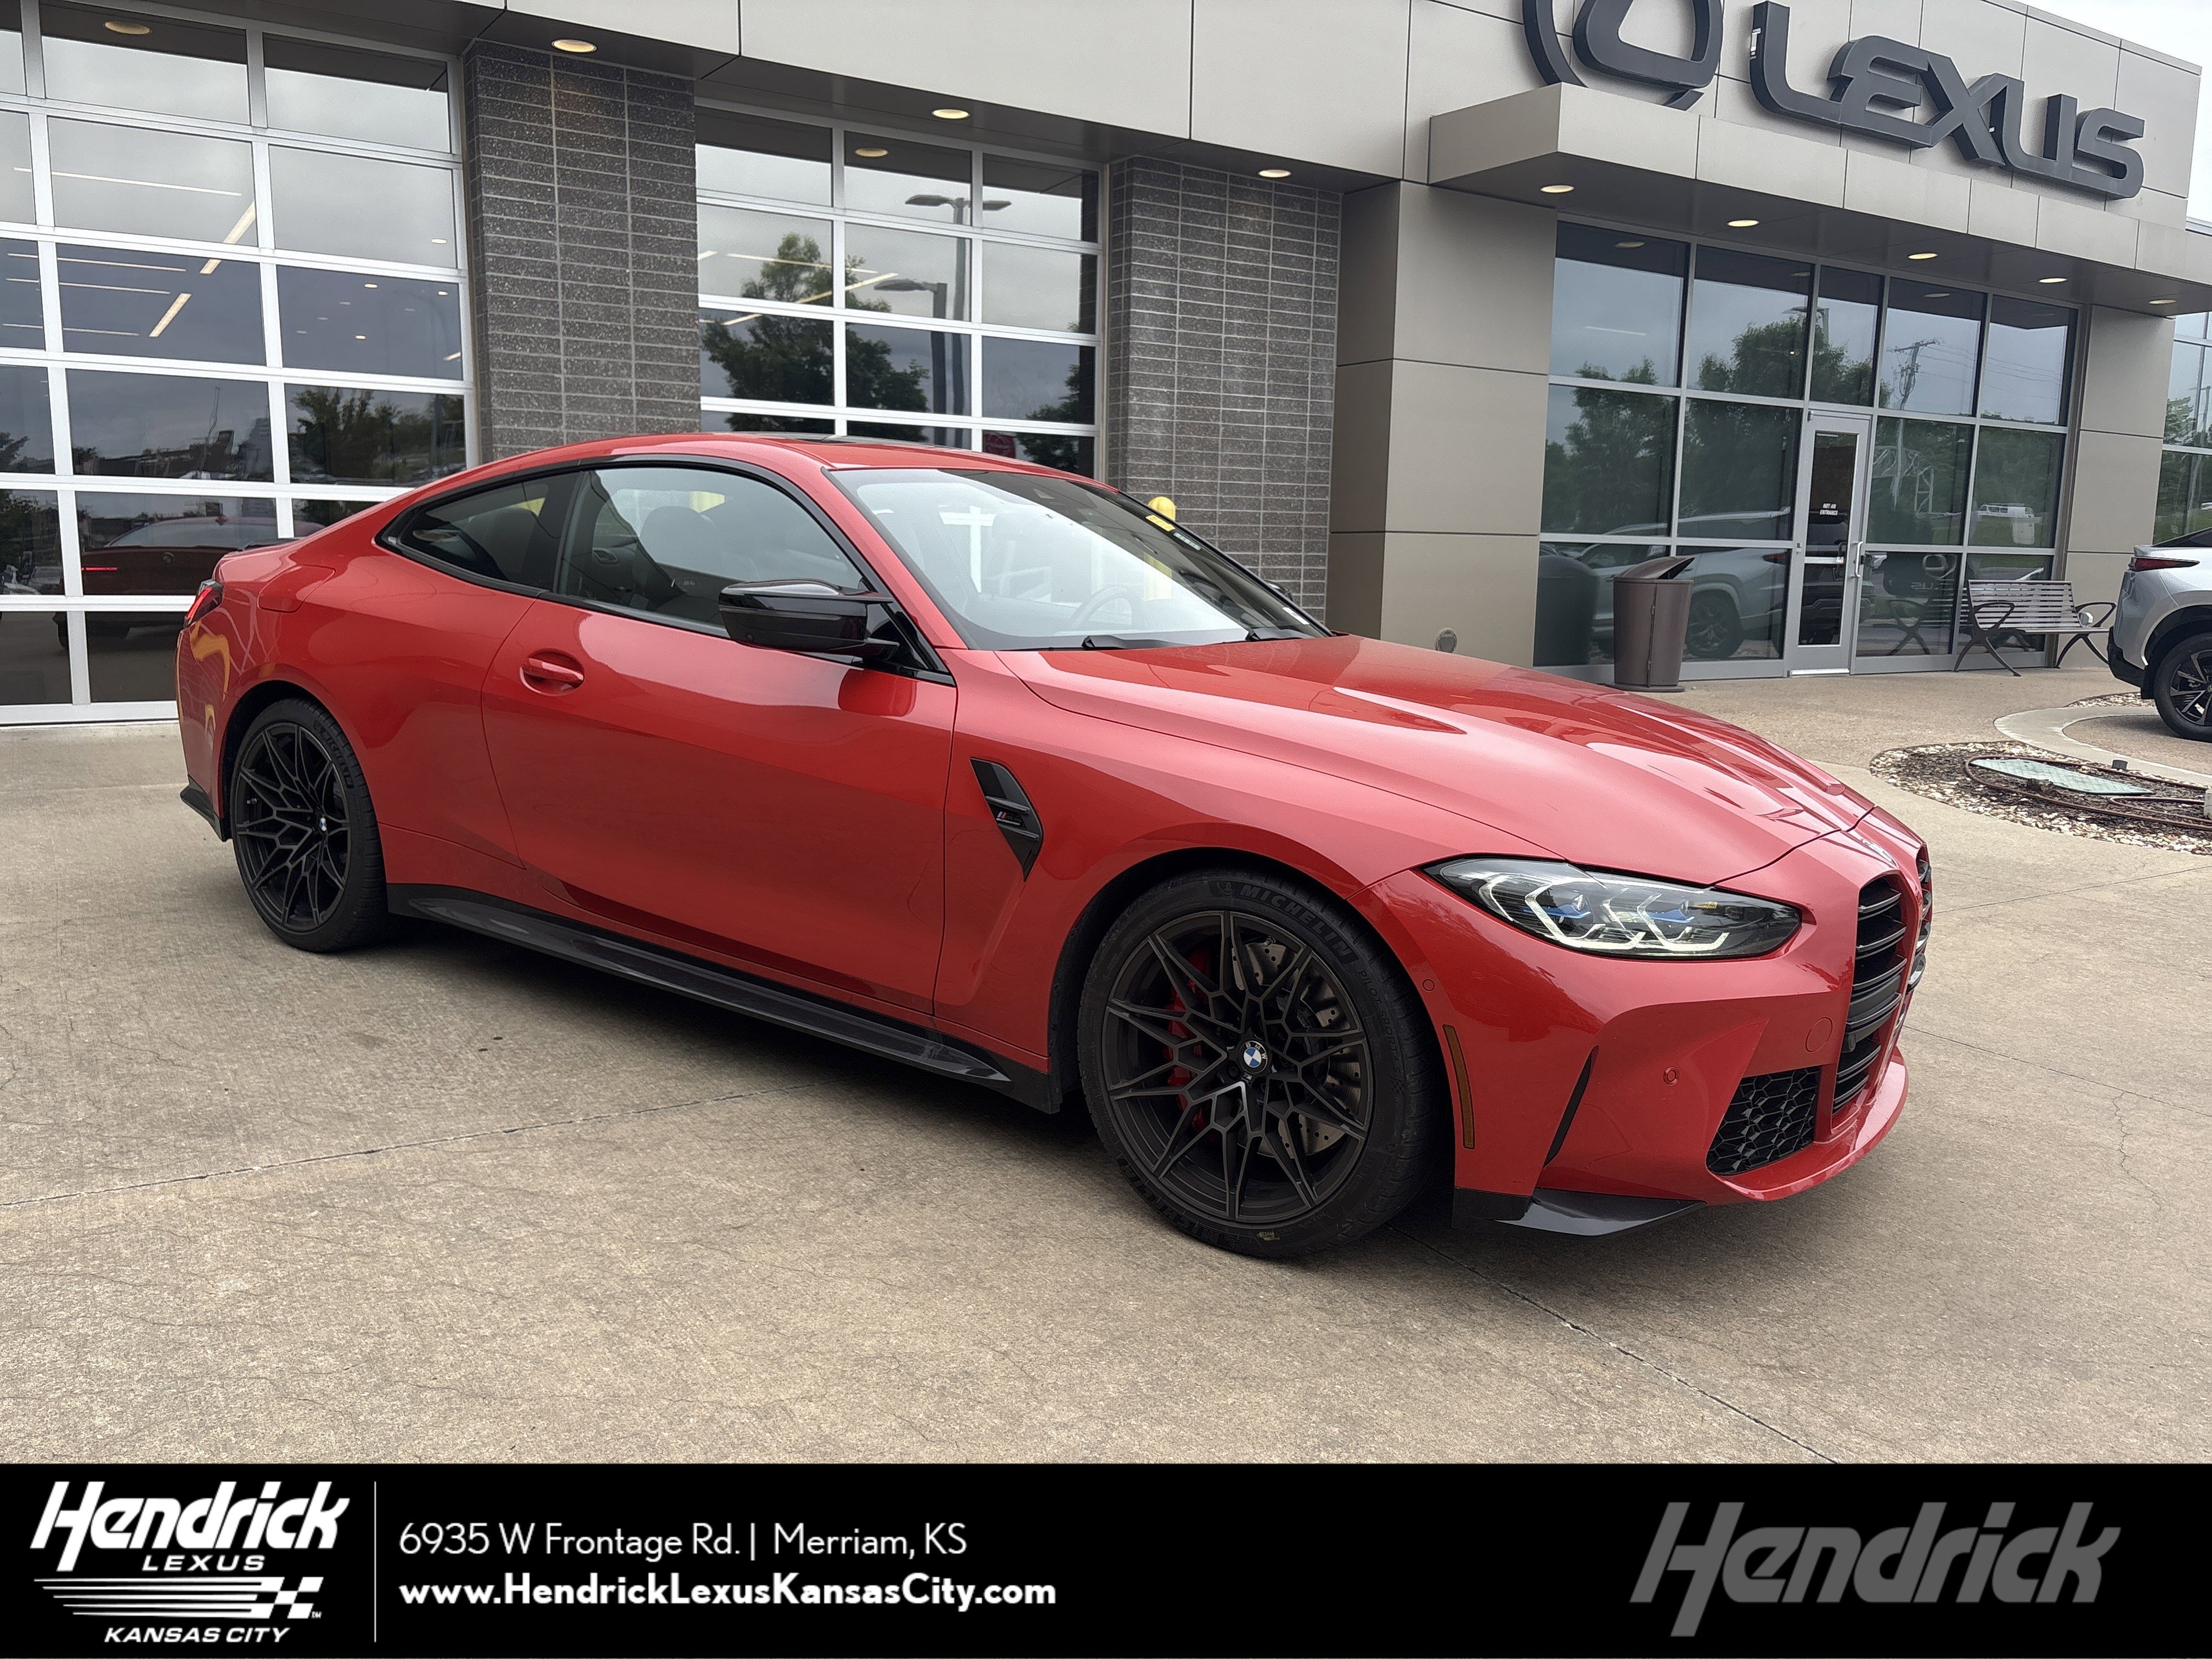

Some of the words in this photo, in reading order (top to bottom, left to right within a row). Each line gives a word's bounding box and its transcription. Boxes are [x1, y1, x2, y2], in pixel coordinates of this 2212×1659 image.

[1750, 2, 2146, 199] LEXUS
[1239, 884, 1355, 959] MICHELIN
[1245, 1042, 1267, 1059] BMW
[1358, 970, 1383, 1005] PILOT
[1378, 1009, 1398, 1057] SPORT
